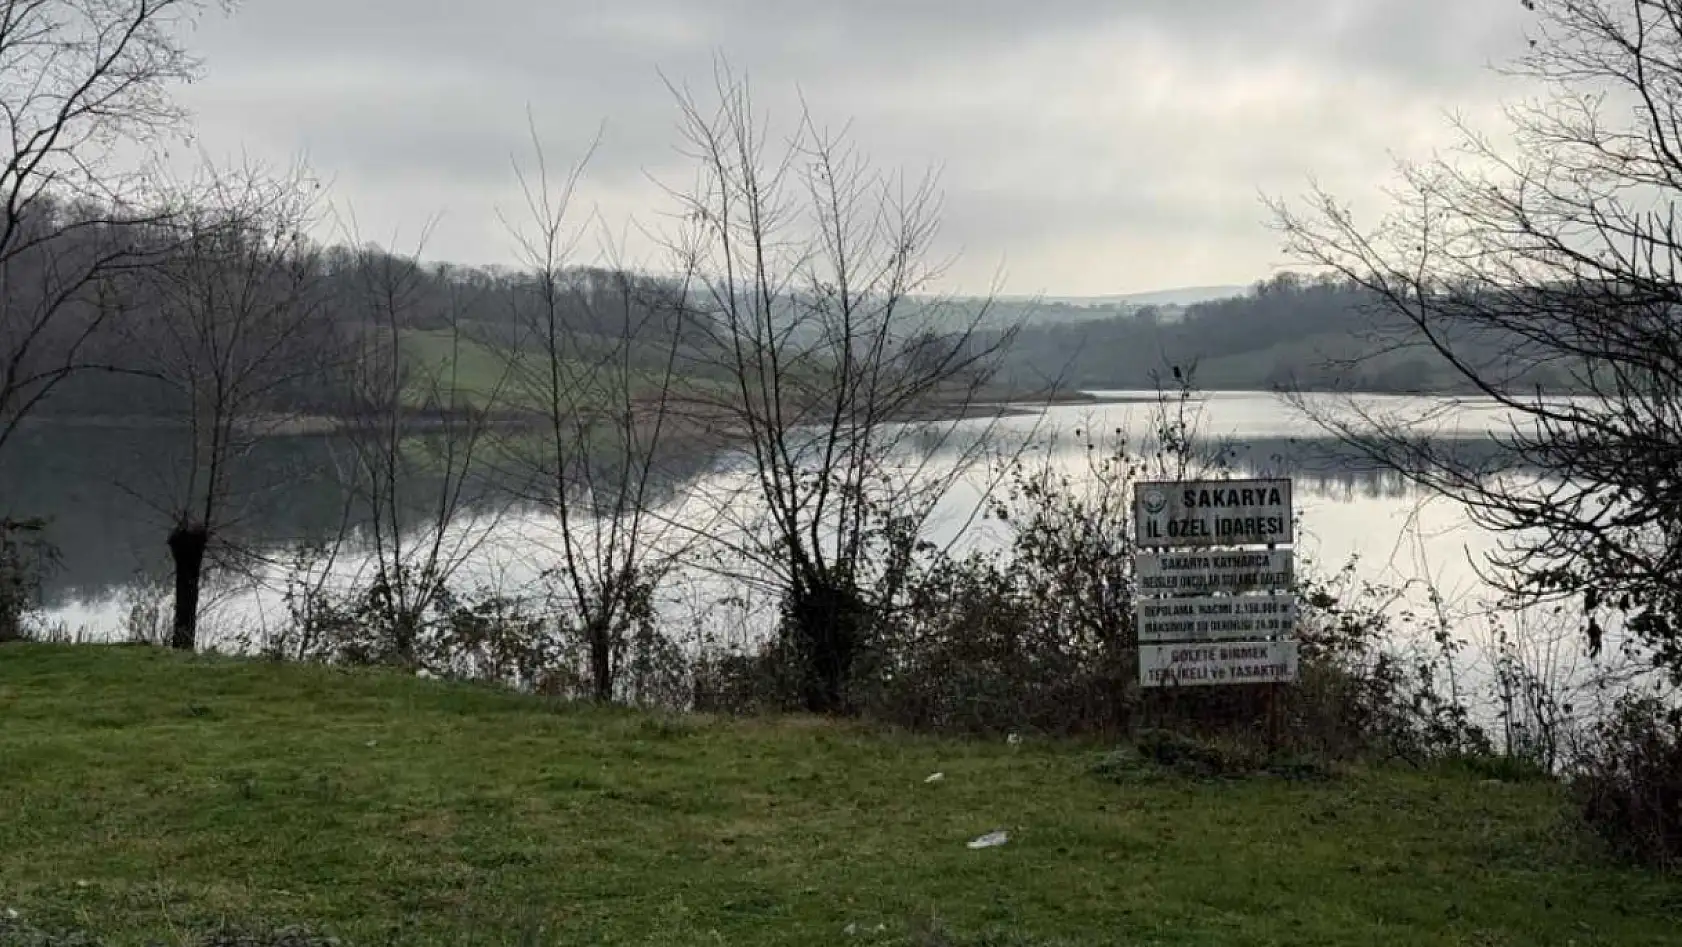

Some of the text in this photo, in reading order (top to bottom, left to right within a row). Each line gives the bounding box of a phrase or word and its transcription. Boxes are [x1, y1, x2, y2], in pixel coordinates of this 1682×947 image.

[1184, 487, 1281, 508] SAKARYA
[1147, 514, 1163, 538] İL
[1215, 512, 1284, 537] İDARESİ
[1161, 557, 1210, 569] SAKARYA
